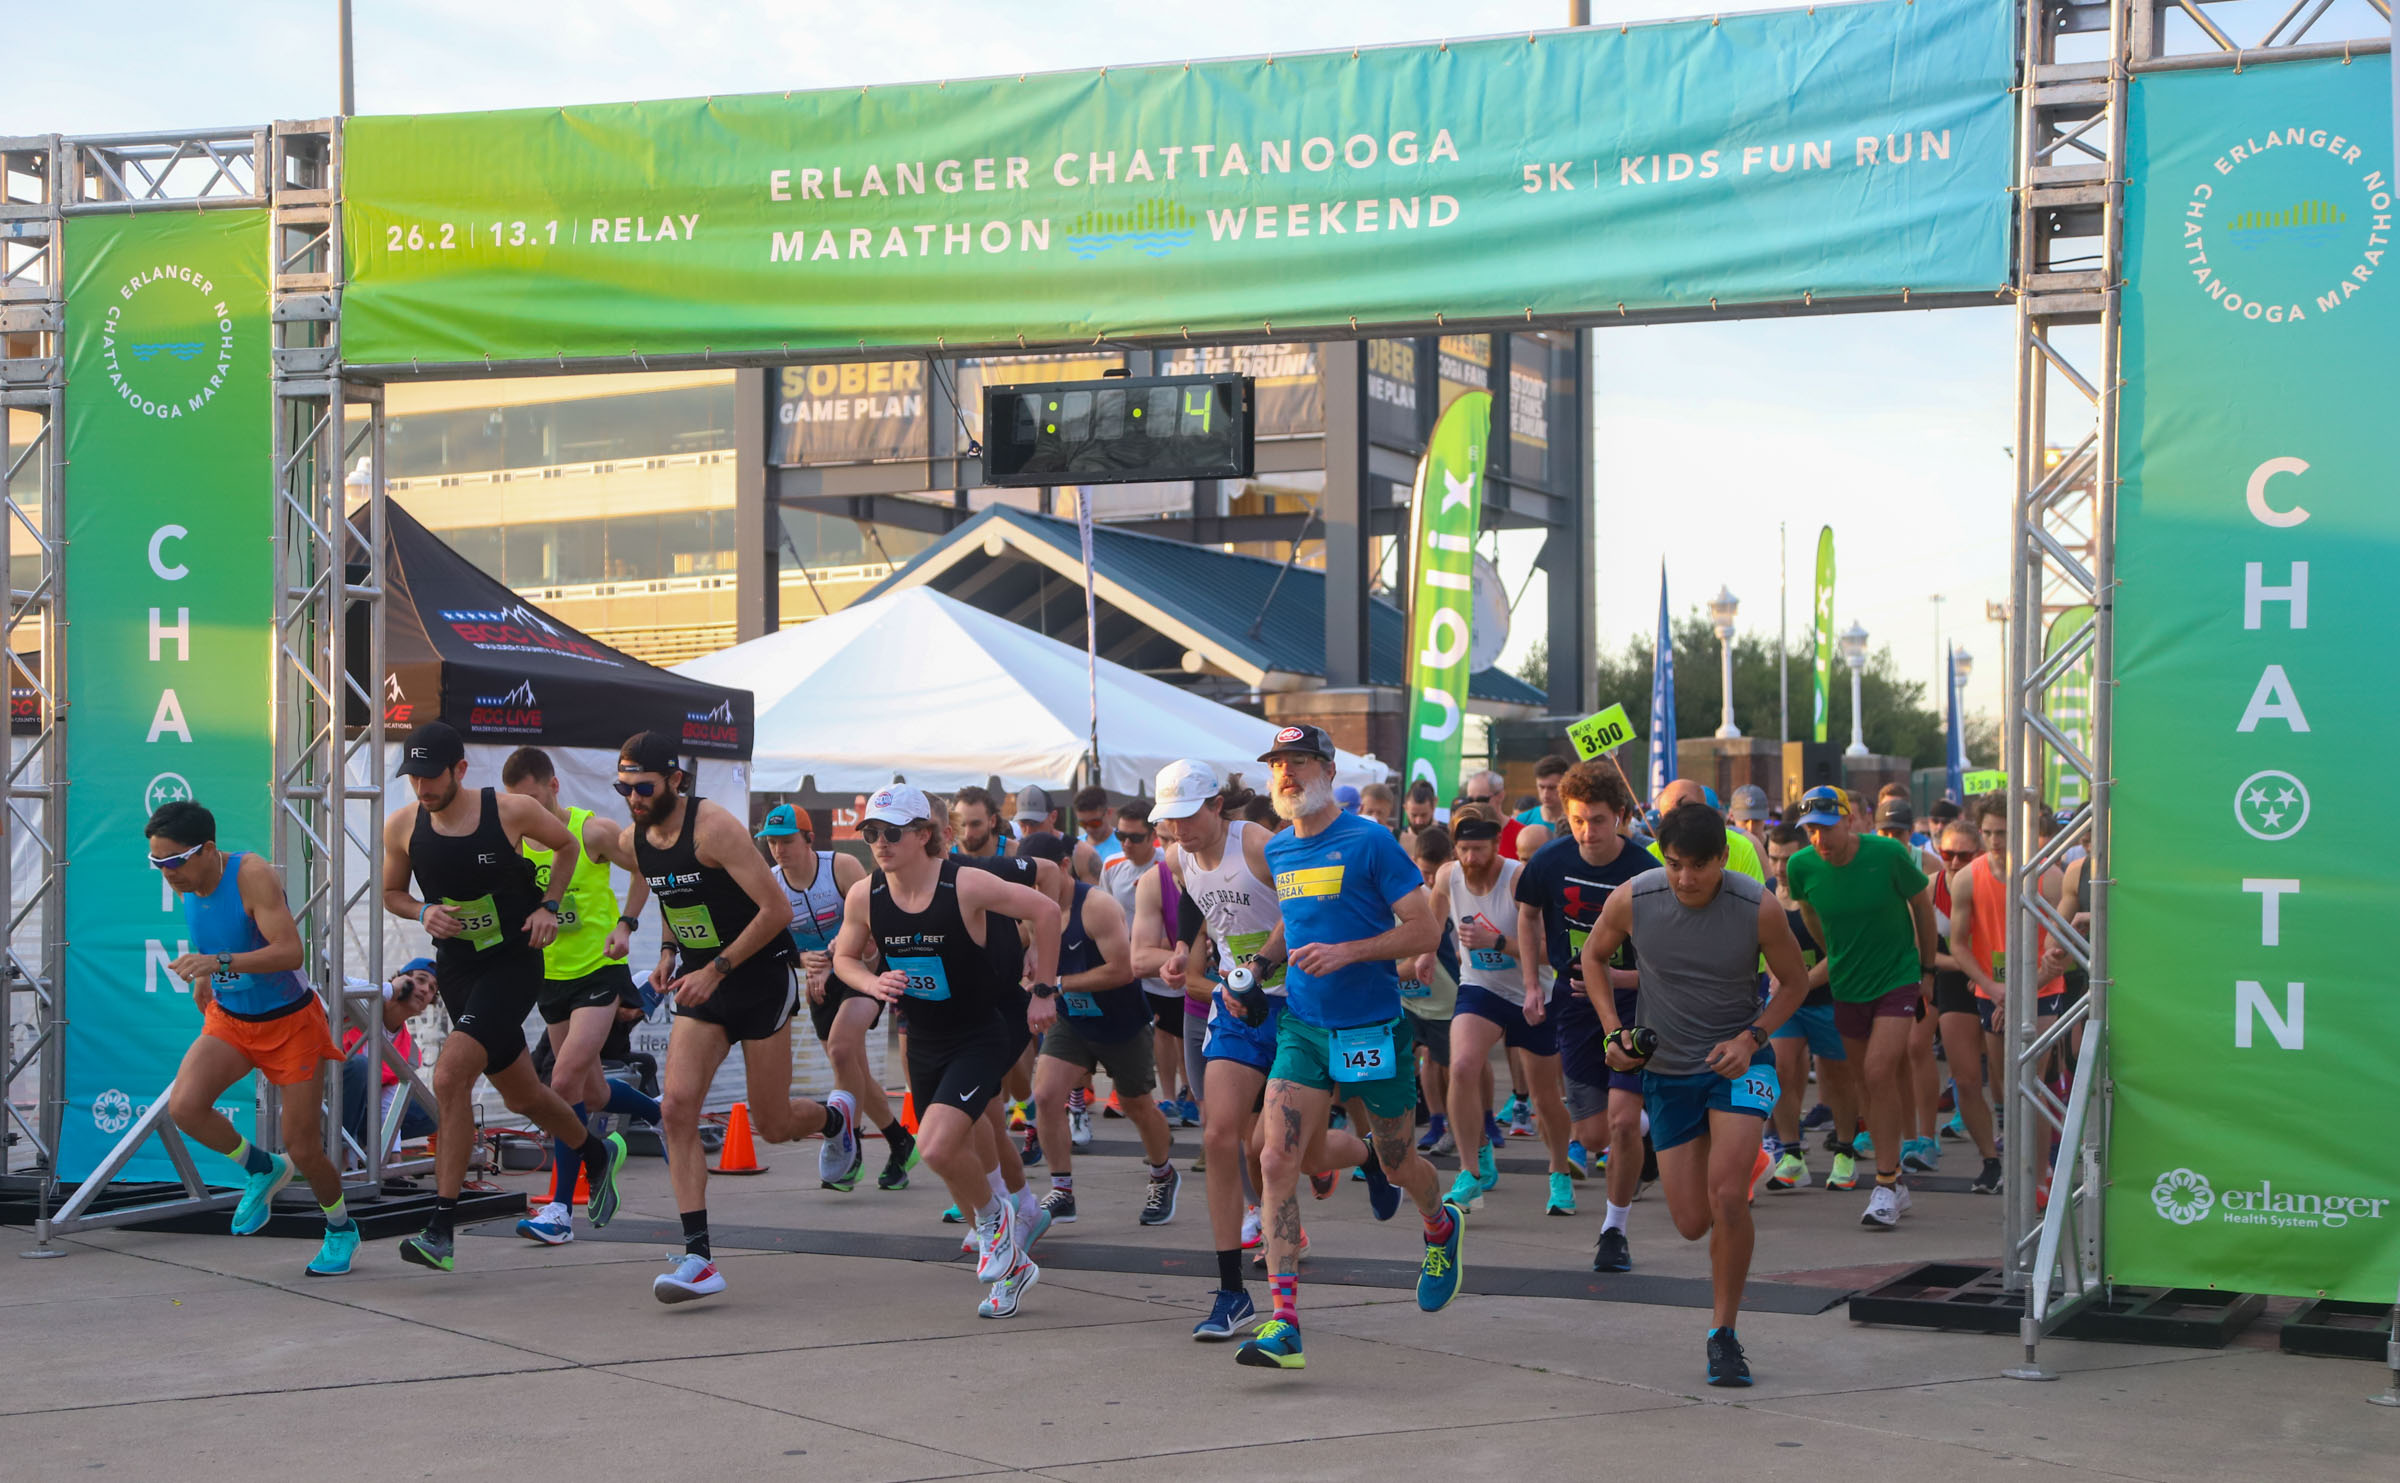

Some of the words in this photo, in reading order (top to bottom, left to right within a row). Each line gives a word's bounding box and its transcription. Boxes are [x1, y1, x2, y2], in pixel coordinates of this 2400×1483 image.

[1522, 161, 1575, 195] 5K
[1619, 150, 1721, 187] KIDS
[1742, 140, 1833, 176] FUN
[1856, 129, 1951, 166] RUN
[2214, 127, 2362, 175] ERLANGER
[769, 156, 1031, 202] ERLANGER
[1052, 128, 1461, 188] CHATTANOOGA
[387, 224, 456, 252] 26.2
[489, 220, 559, 248] 13.1
[590, 214, 700, 244] RELAY
[769, 217, 1051, 263] MARATHON
[1205, 195, 1461, 243] WEEKEND
[2184, 183, 2306, 323] CHATTANOOGA
[2316, 170, 2392, 312] MARATHON
[120, 264, 214, 300] ERLANGER
[103, 306, 183, 419] CHATTANOOGA
[188, 301, 234, 412] MARATHON
[1162, 360, 1231, 377] DRIVE
[1233, 352, 1316, 376] DRUNK
[781, 361, 921, 398] SOBER
[1385, 380, 1416, 410] PLAN
[780, 400, 848, 424] GAME
[854, 395, 921, 419] PLAN
[451, 624, 529, 644] BCC
[471, 707, 504, 724] BCC
[506, 709, 544, 726] LIVE
[682, 722, 708, 739] BCC
[710, 725, 738, 742] LIVE
[1582, 722, 1624, 753] 3:00
[646, 876, 666, 886] FLEET
[676, 872, 700, 884] FEET
[1278, 873, 1295, 884] FAST
[1198, 891, 1217, 913] FAST
[1217, 890, 1251, 906] BREAK
[674, 925, 708, 938] 1512
[885, 936, 912, 944] FLEET
[923, 935, 944, 943] FEET
[1478, 952, 1503, 963] 133
[1343, 1049, 1381, 1068] 143
[1746, 1080, 1774, 1101] 124
[2221, 1180, 2390, 1228] erlanger
[2224, 1212, 2267, 1225] Health
[2271, 1215, 2318, 1229] System
